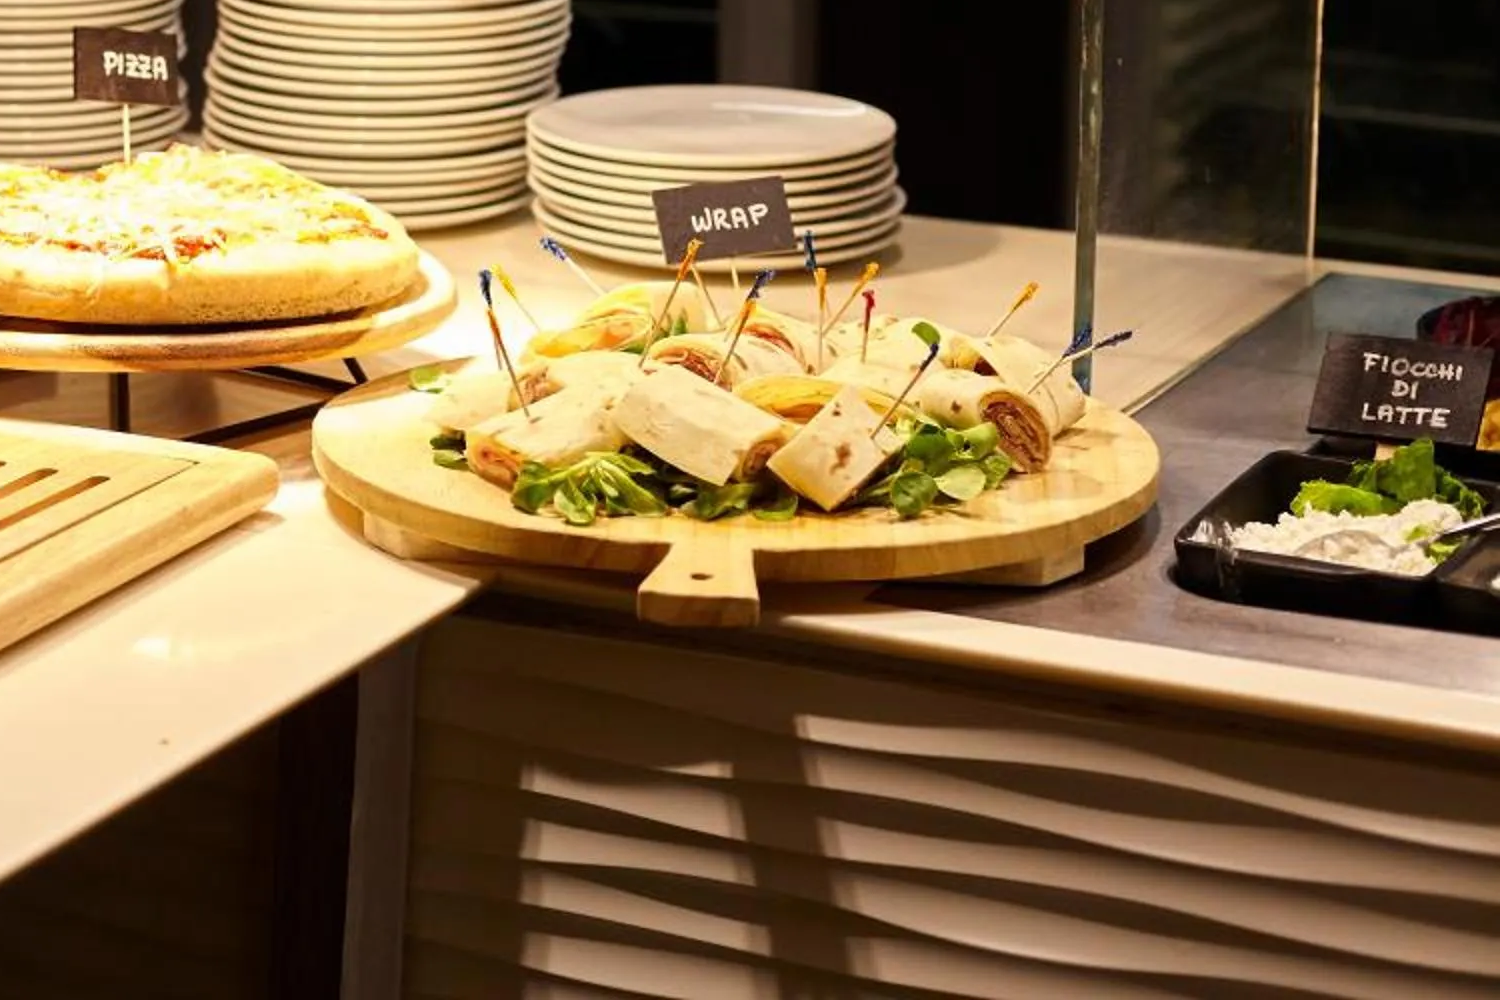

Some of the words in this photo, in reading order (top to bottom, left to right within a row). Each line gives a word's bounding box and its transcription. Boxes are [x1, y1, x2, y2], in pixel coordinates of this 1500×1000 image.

[103, 50, 168, 82] PIZZA
[691, 203, 769, 232] WRAP
[1363, 352, 1464, 381] FIOCCHI
[1391, 379, 1419, 400] DI
[1361, 402, 1451, 429] LATTE
